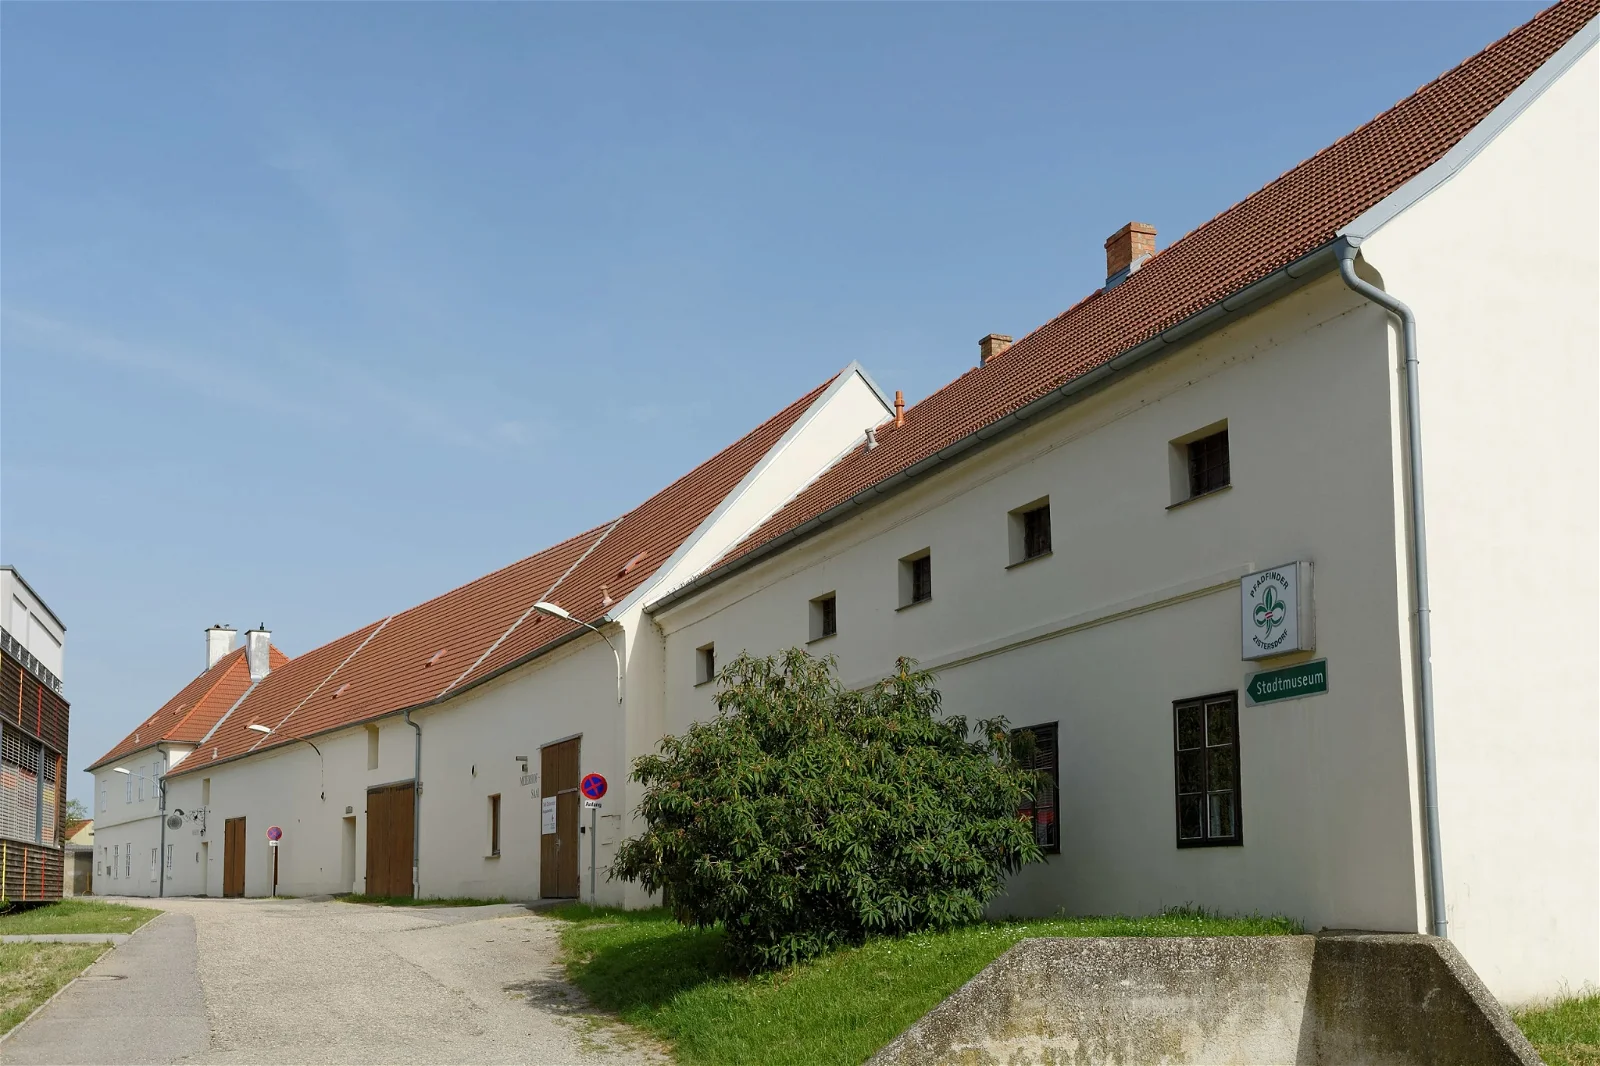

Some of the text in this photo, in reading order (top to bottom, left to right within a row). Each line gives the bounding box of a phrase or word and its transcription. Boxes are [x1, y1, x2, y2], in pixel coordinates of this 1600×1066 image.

[1250, 571, 1289, 597] PFADFINDER
[1252, 628, 1288, 650] ZISTERSDORF
[1256, 672, 1324, 695] Stadtmuseum
